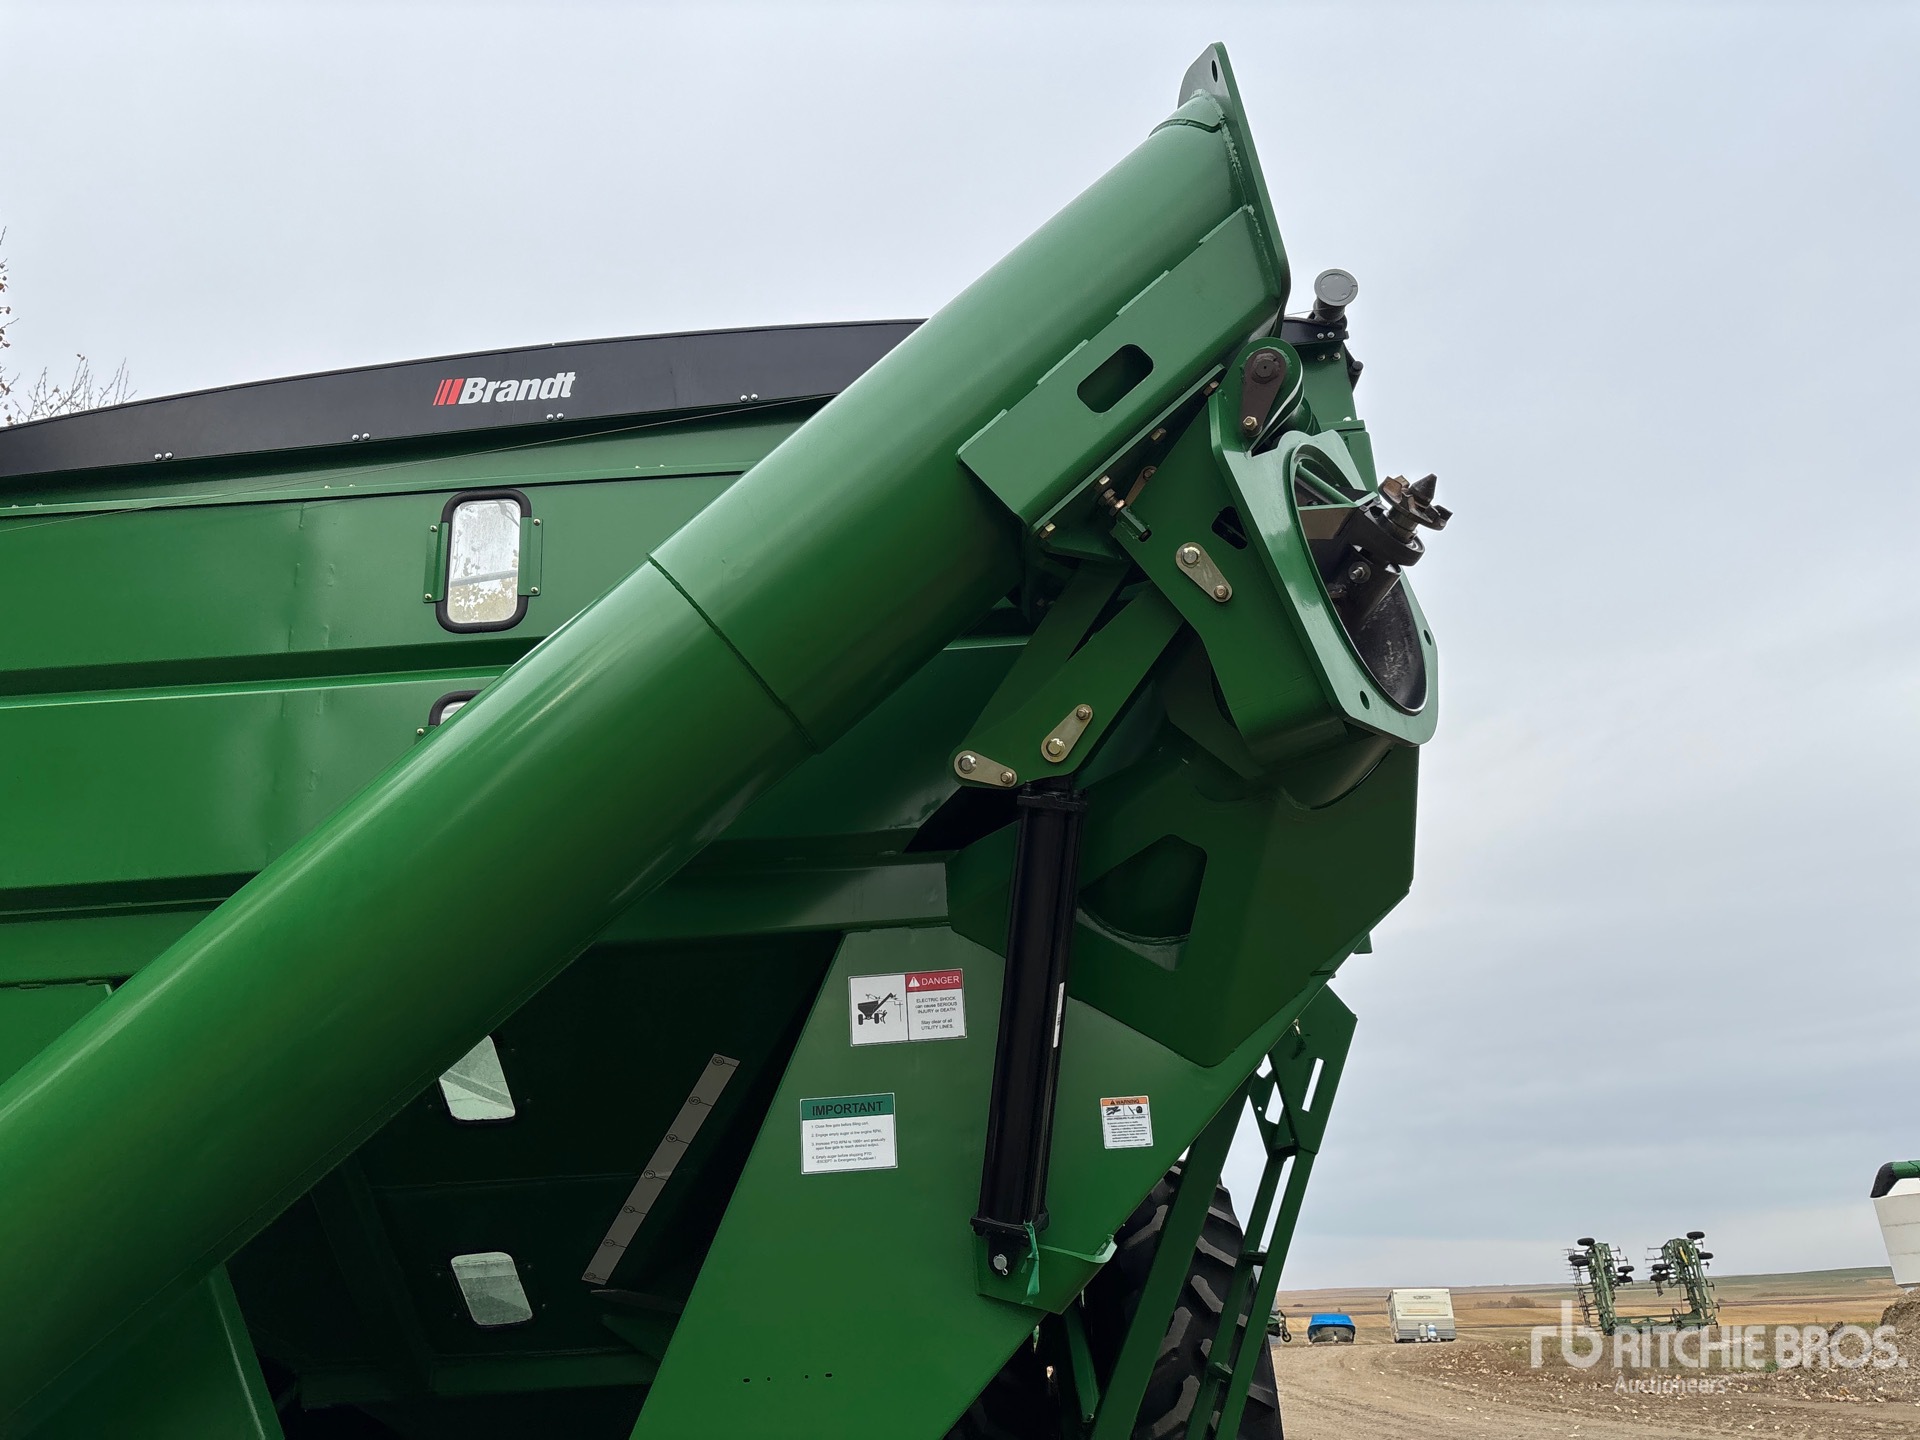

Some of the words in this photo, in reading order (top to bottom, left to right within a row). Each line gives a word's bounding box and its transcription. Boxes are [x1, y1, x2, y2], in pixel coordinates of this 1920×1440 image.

[458, 372, 576, 404] Brandt
[922, 975, 959, 986] DANGER
[812, 1101, 883, 1116] IMPORTANT
